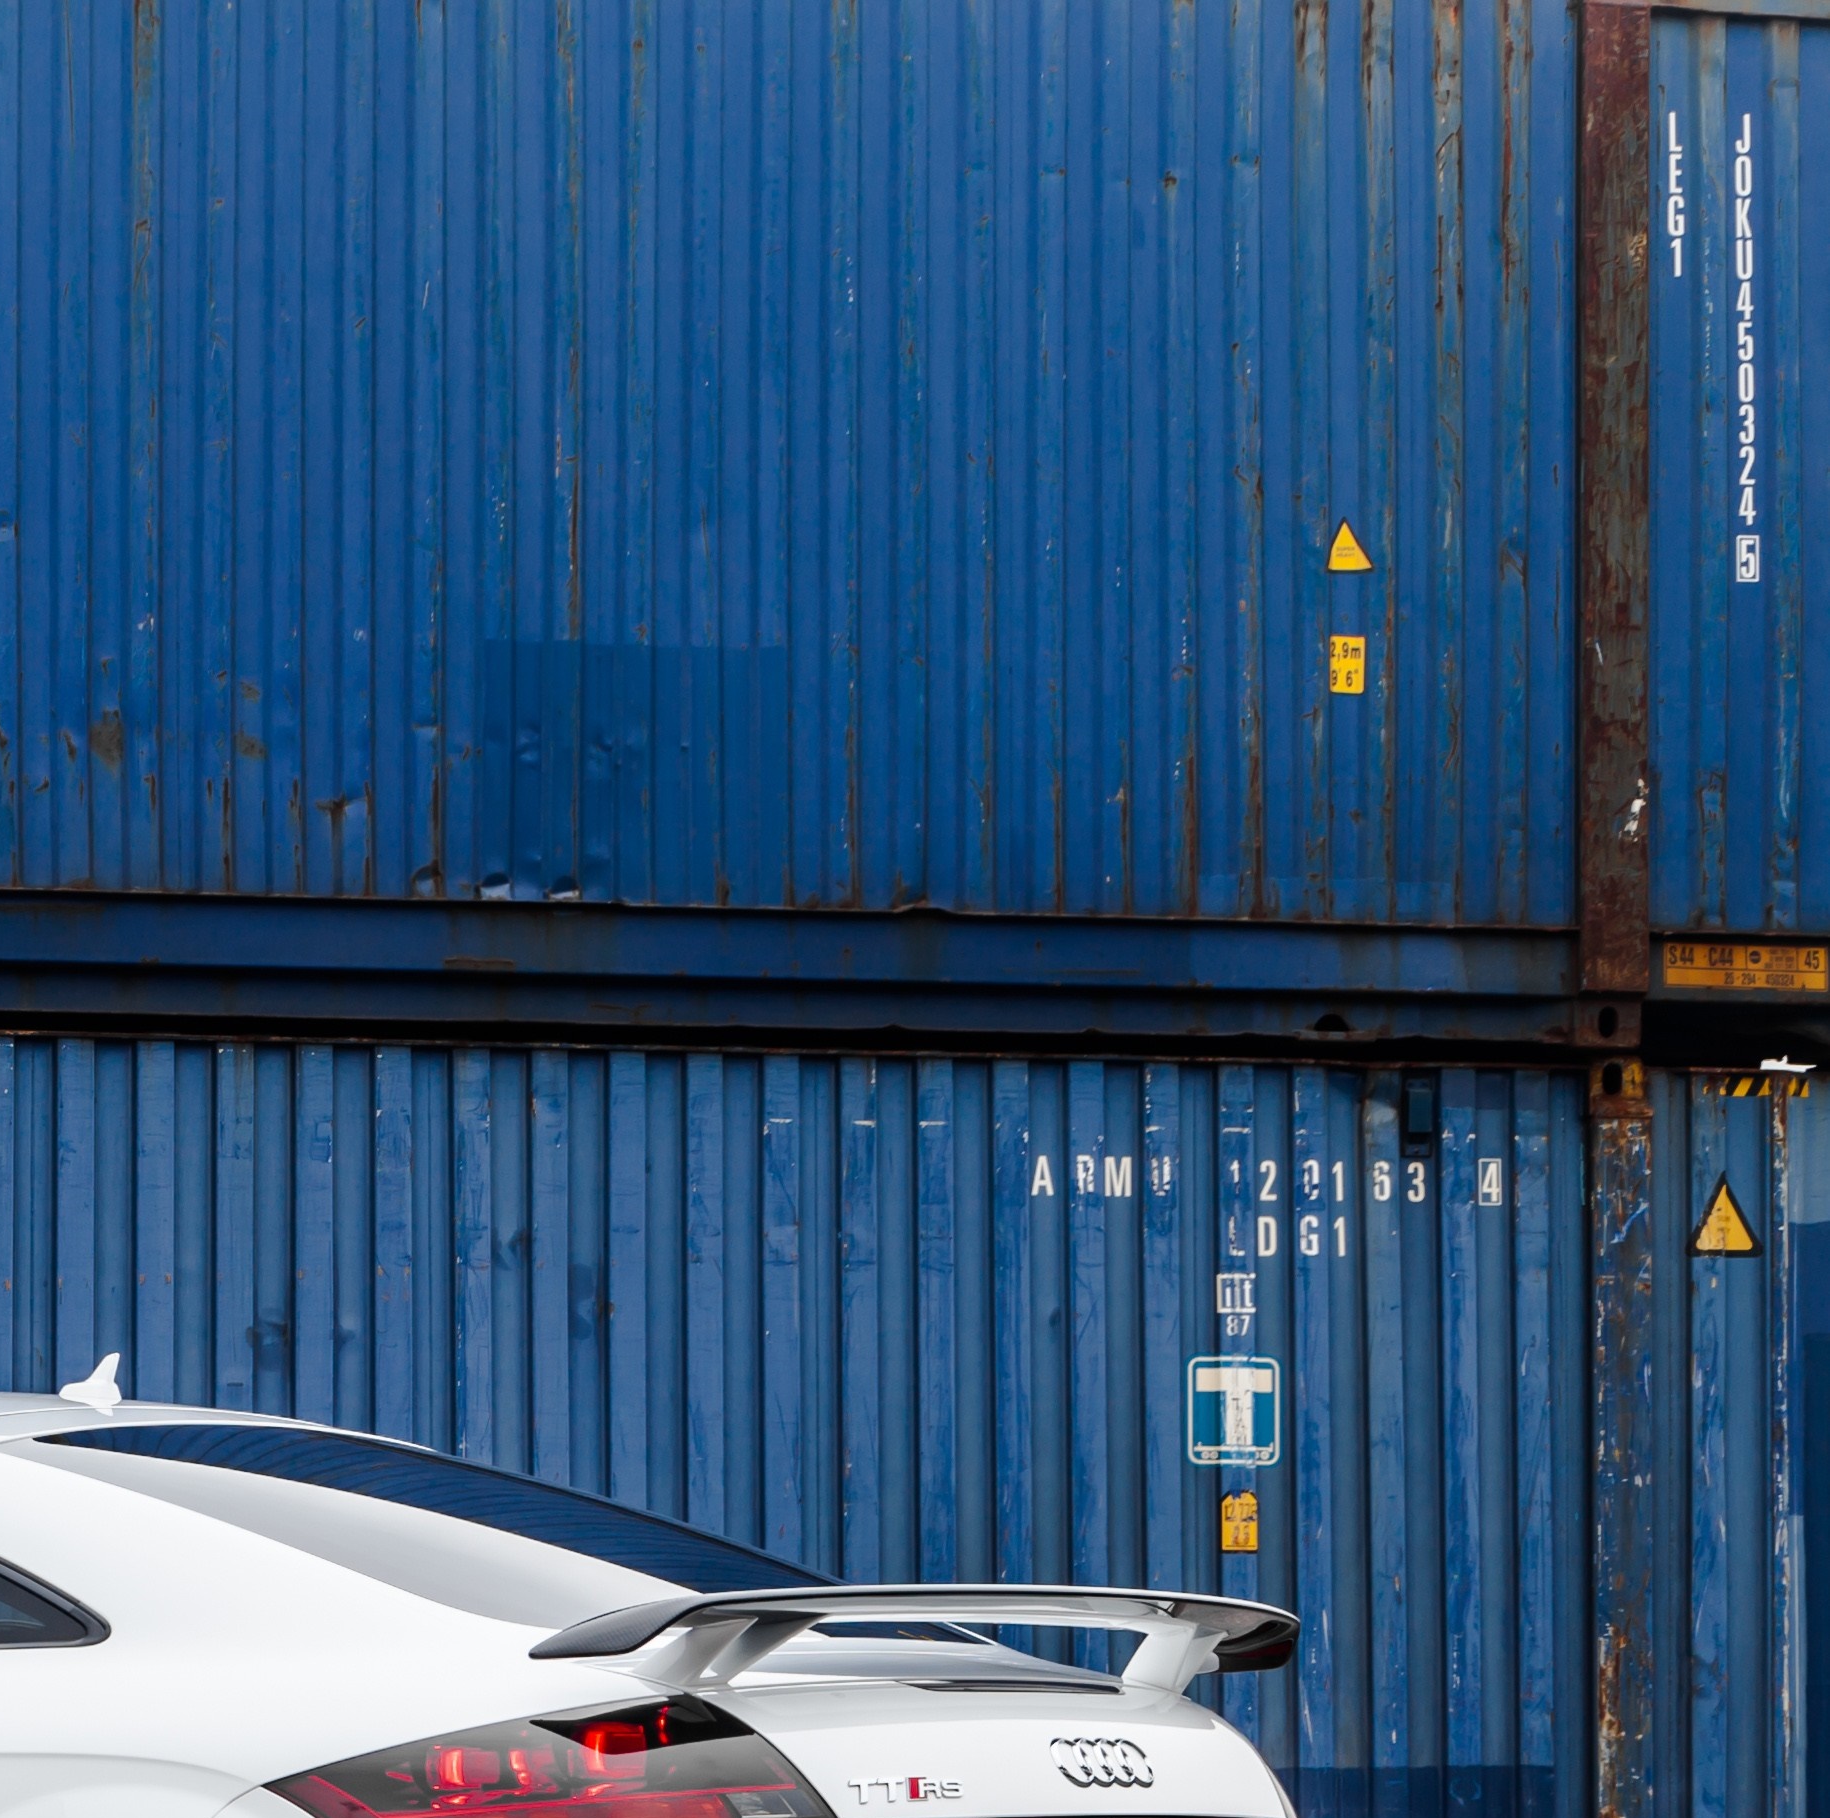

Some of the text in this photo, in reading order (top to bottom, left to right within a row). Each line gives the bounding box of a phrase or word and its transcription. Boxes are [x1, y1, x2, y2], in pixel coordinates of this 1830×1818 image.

[1804, 950, 1820, 970] 45
[1481, 1162, 1501, 1203] 4
[1225, 1314, 1251, 1337] 87
